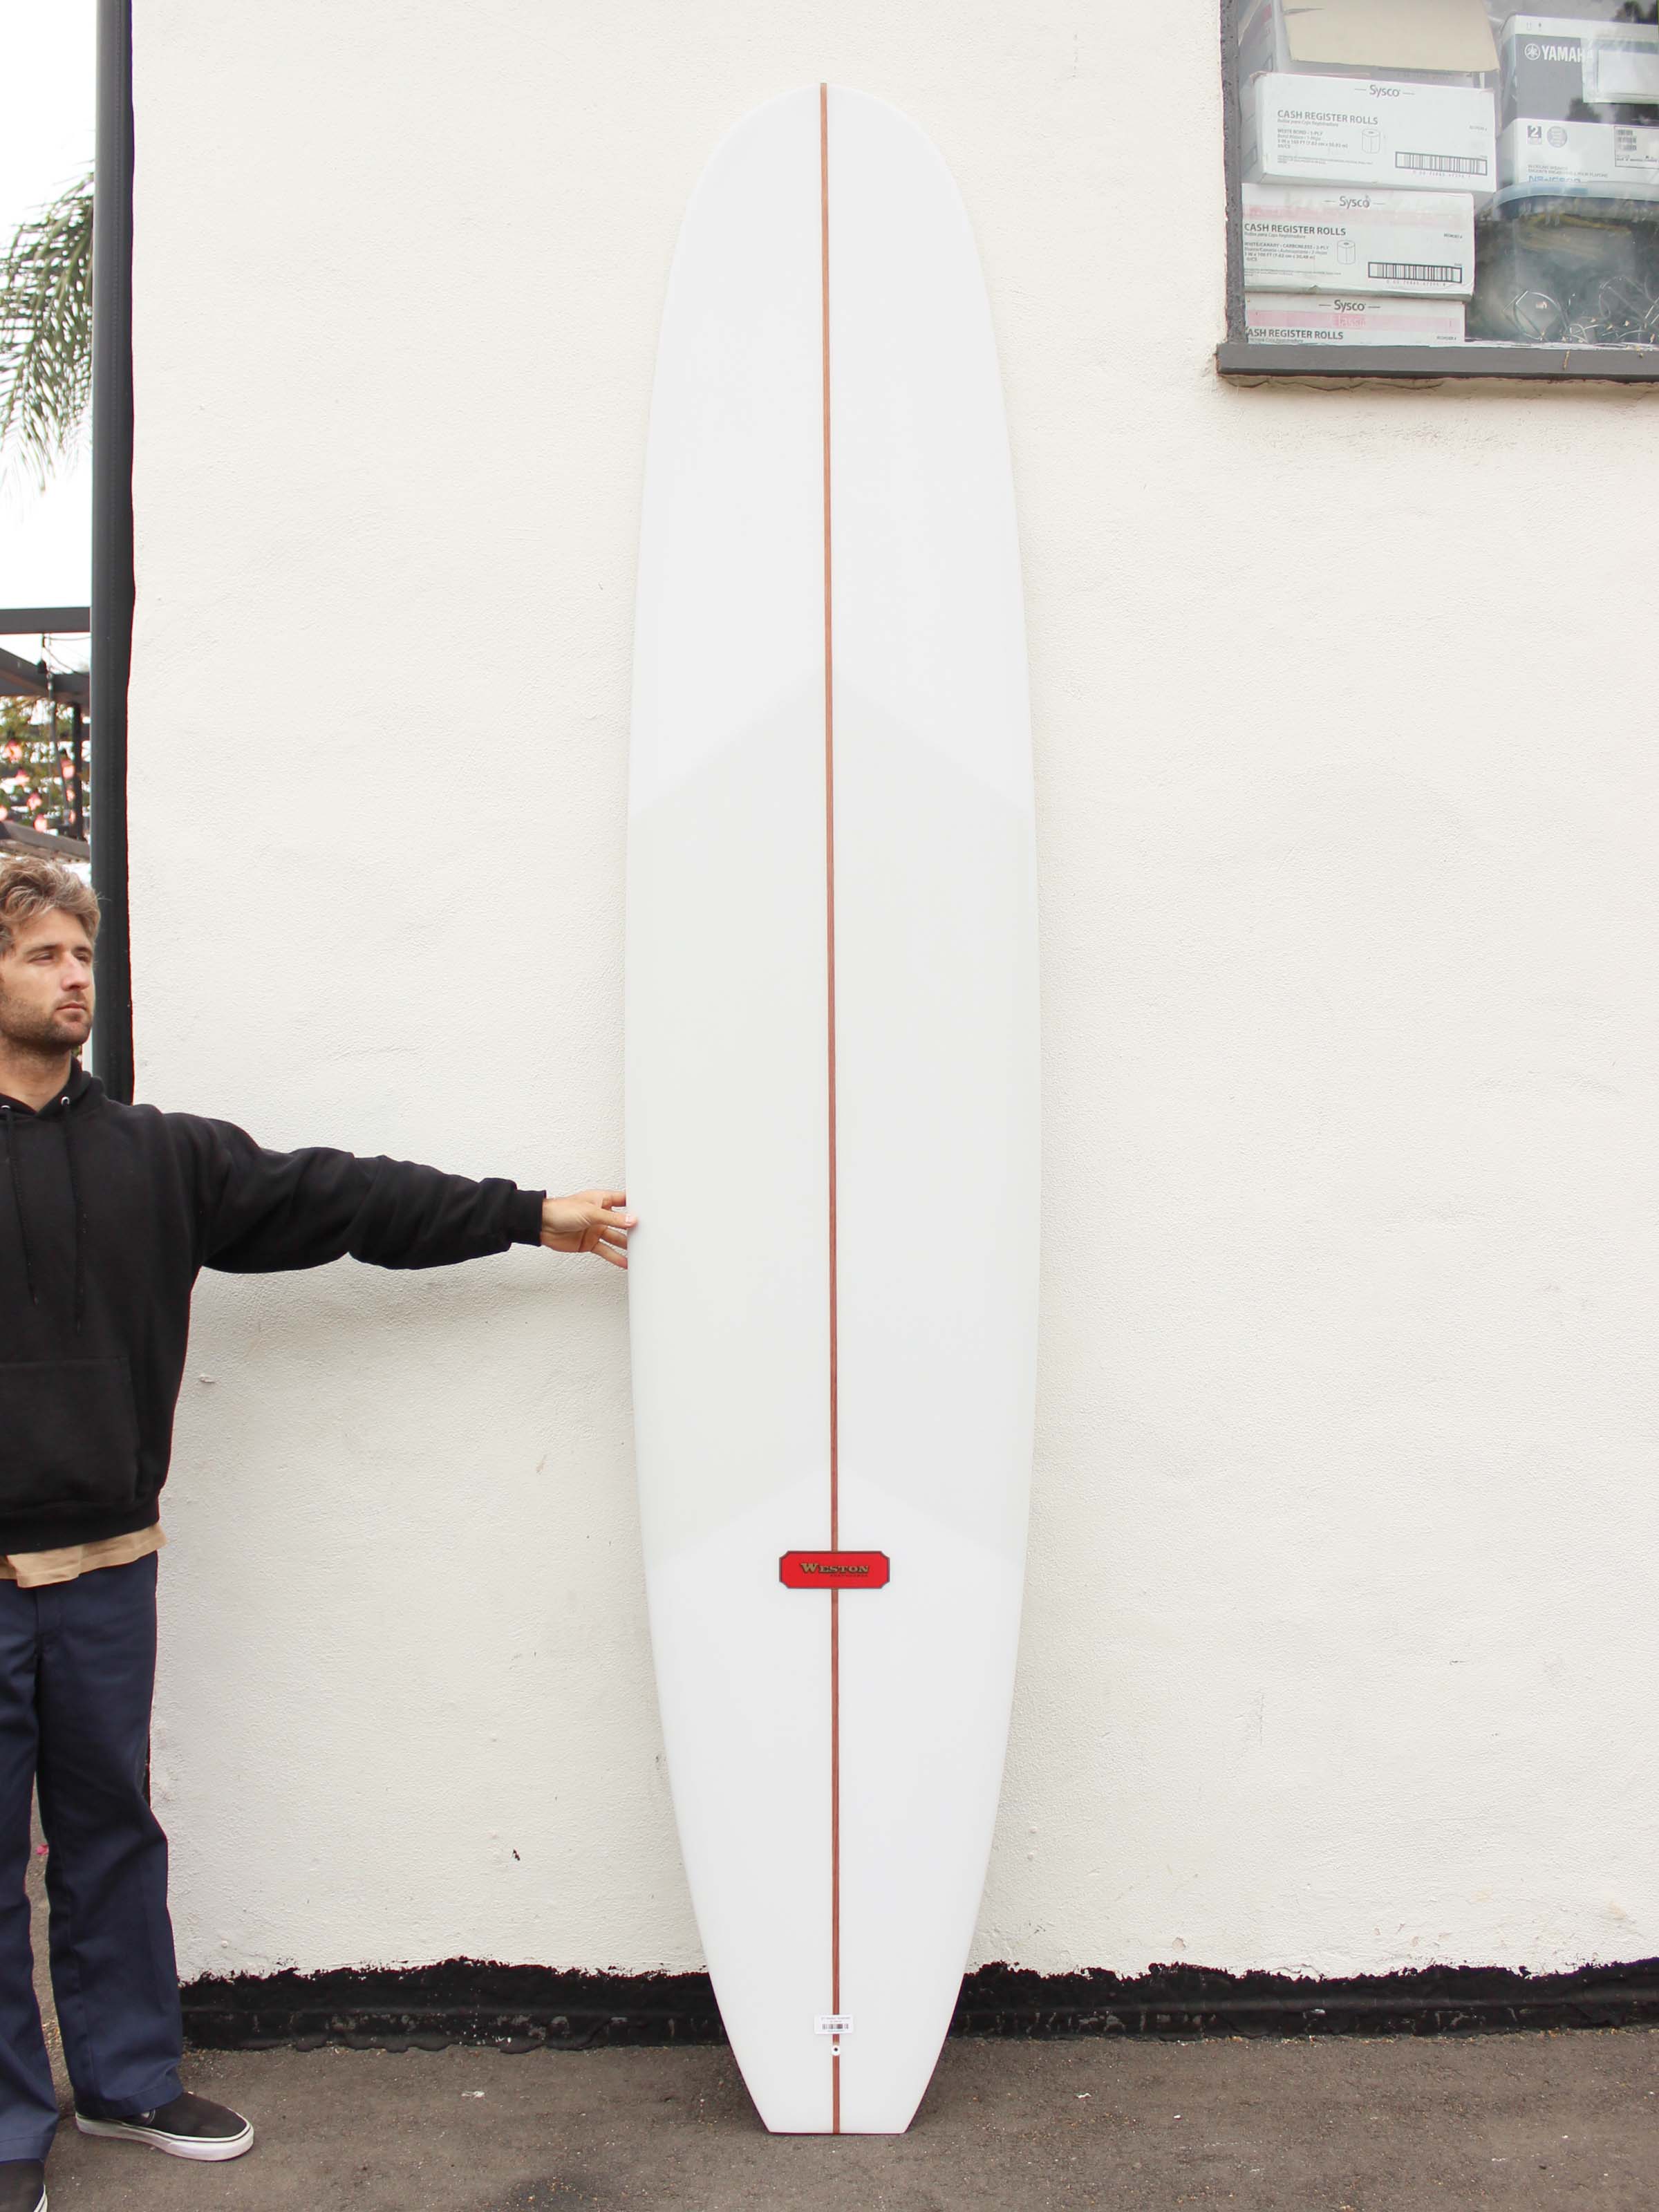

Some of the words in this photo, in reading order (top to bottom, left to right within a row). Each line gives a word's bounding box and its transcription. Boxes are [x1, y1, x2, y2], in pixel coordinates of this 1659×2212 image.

[1369, 84, 1400, 98] Sysco
[1277, 110, 1302, 119] CASH
[1305, 112, 1347, 122] REGISTER
[1350, 115, 1378, 125] ROLLS
[1530, 126, 1539, 138] 2
[1339, 196, 1370, 210] Sysco
[1244, 223, 1268, 232] CASH
[1272, 225, 1315, 234] REGISTER
[1317, 227, 1346, 236] ROLLS
[1334, 299, 1365, 312] Sysco
[1247, 328, 1266, 337] ASH
[1268, 329, 1312, 338] REGISTER
[1315, 331, 1343, 340] ROLLS
